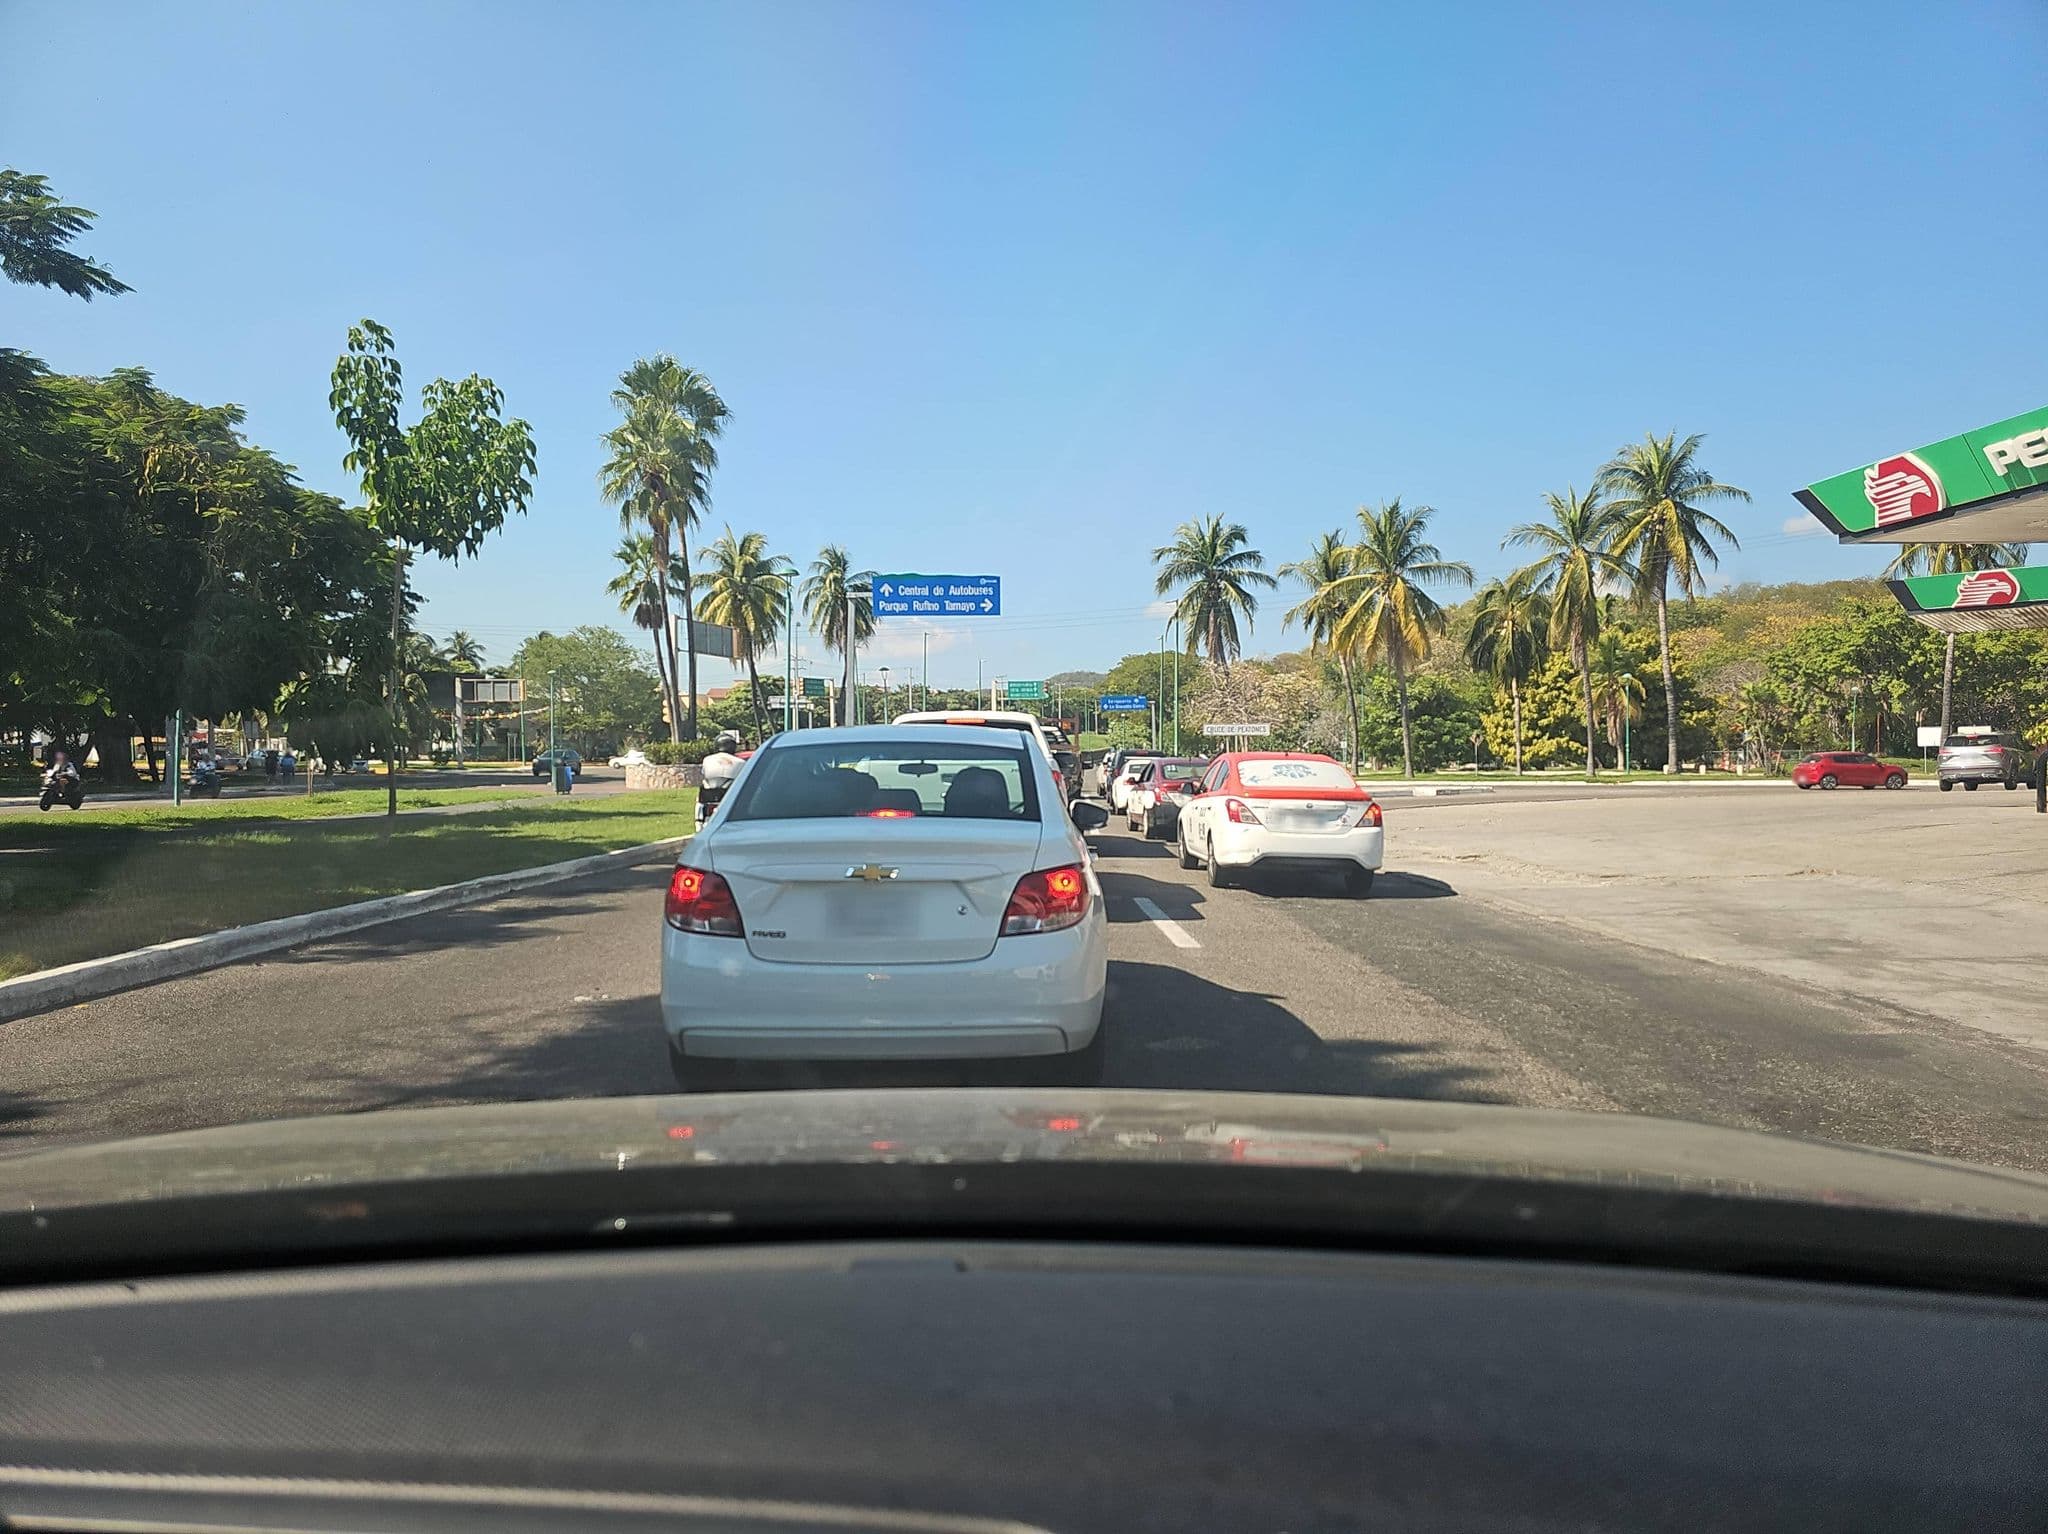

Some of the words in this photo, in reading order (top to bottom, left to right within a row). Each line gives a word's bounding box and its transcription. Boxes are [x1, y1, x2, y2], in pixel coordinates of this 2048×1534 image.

[1983, 427, 2048, 476] PE
[898, 585, 929, 596] Central
[933, 585, 944, 596] de
[949, 585, 994, 596] Autobuses
[879, 601, 908, 613] Parque
[913, 600, 940, 611] Rufino
[944, 600, 976, 612] Tamayo
